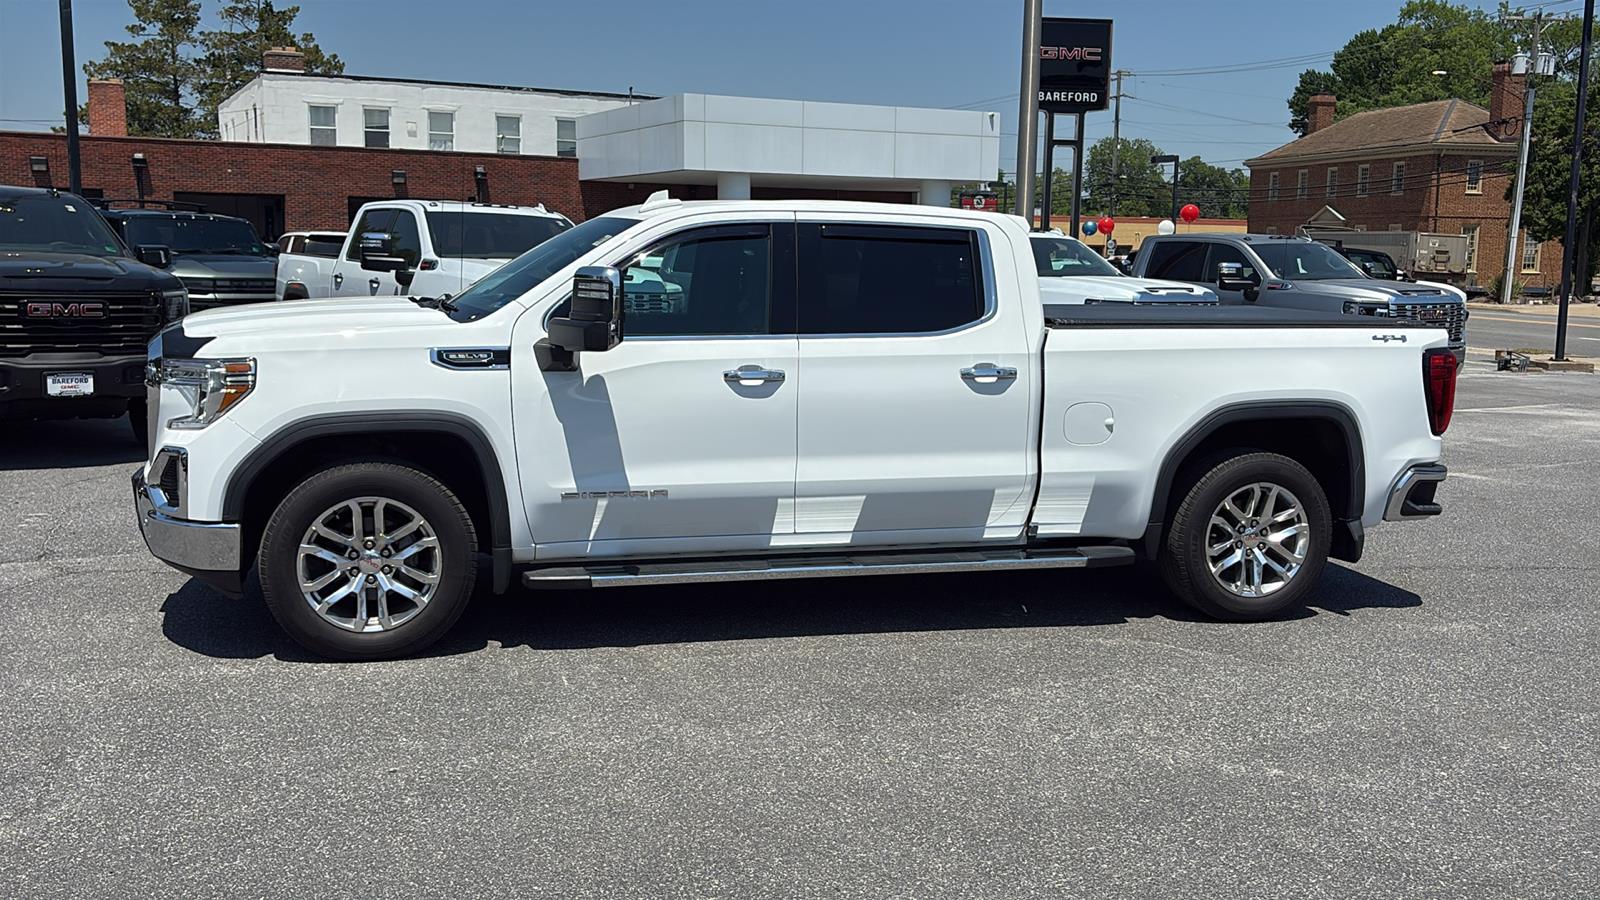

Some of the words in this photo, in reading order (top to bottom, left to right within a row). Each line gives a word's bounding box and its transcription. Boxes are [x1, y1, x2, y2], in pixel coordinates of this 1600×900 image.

[1040, 46, 1102, 60] GMC
[1038, 91, 1098, 102] BAREFORD
[27, 302, 104, 317] GMC
